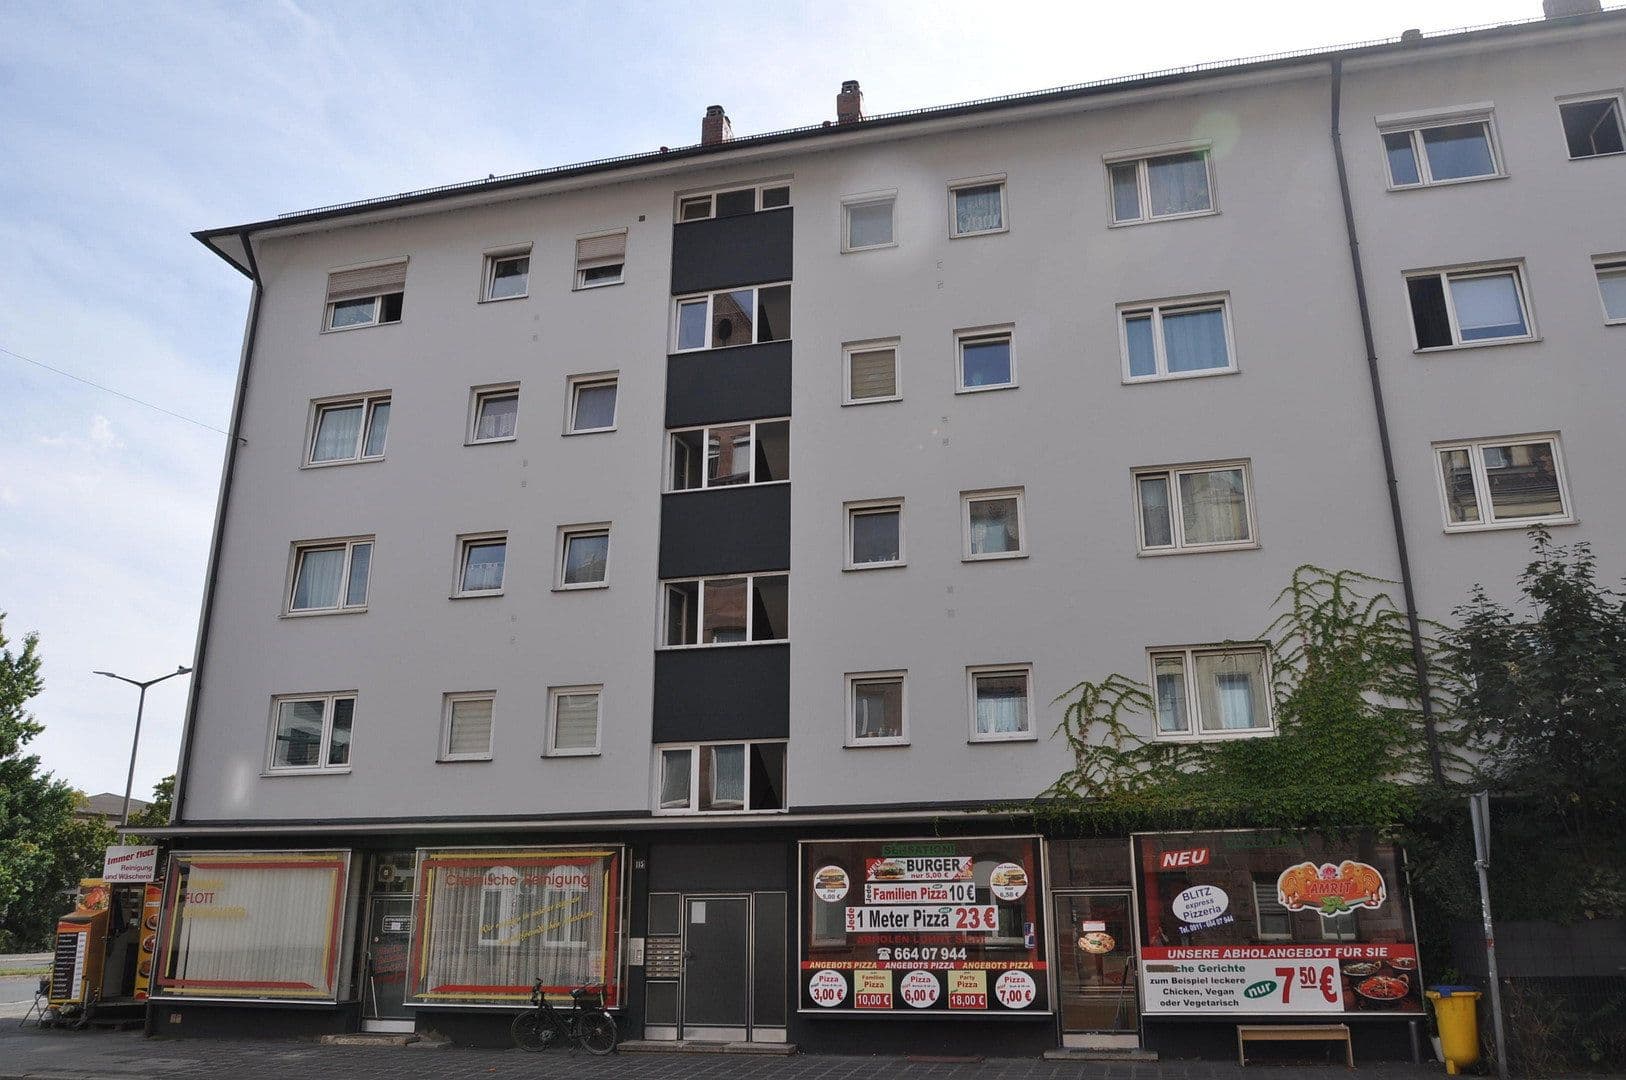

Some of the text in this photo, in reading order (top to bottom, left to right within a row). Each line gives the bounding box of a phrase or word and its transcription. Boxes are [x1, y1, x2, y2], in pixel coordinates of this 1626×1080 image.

[136, 848, 155, 859] flott
[1163, 850, 1206, 867] NEU
[120, 864, 153, 872] Reinigung
[906, 859, 960, 872] BURGER
[446, 873, 518, 886] Chemische
[873, 887, 917, 900] Familien
[920, 887, 948, 900] Pizza
[1182, 887, 1211, 901] BLITZ
[1310, 882, 1351, 894] AMRIT
[184, 892, 215, 904] FLOTT
[1185, 897, 1214, 910] express
[847, 908, 855, 930] Jede
[857, 910, 863, 928] 1
[869, 910, 909, 928] Meter
[913, 909, 950, 928] Pizza
[1183, 905, 1221, 920] Pizzeria
[894, 947, 967, 960] 664 07 944
[1167, 946, 1388, 959] UNSERE ABHOLANGEBOT FÜR SIE
[809, 961, 1034, 969] ANGEBOTS PIZZA ANGEBOTS PIZZA ANGEBOTS PIZZA
[1197, 964, 1246, 973] Gerichte
[818, 975, 839, 983] Pizza
[910, 975, 931, 983] Pizza
[1171, 977, 1208, 986] Beispiel
[1248, 966, 1338, 1004] nur 7 50 €
[814, 988, 834, 1002] 3,00
[837, 988, 844, 1000] €
[904, 989, 936, 1003] 6,00 €
[999, 989, 1032, 1004] 7,00 €
[1162, 988, 1234, 997] Chicken, Vegan
[857, 994, 890, 1006] 10,00 €
[951, 994, 985, 1006] 18,00 €
[1160, 999, 1239, 1008] oder Vegetarisch
